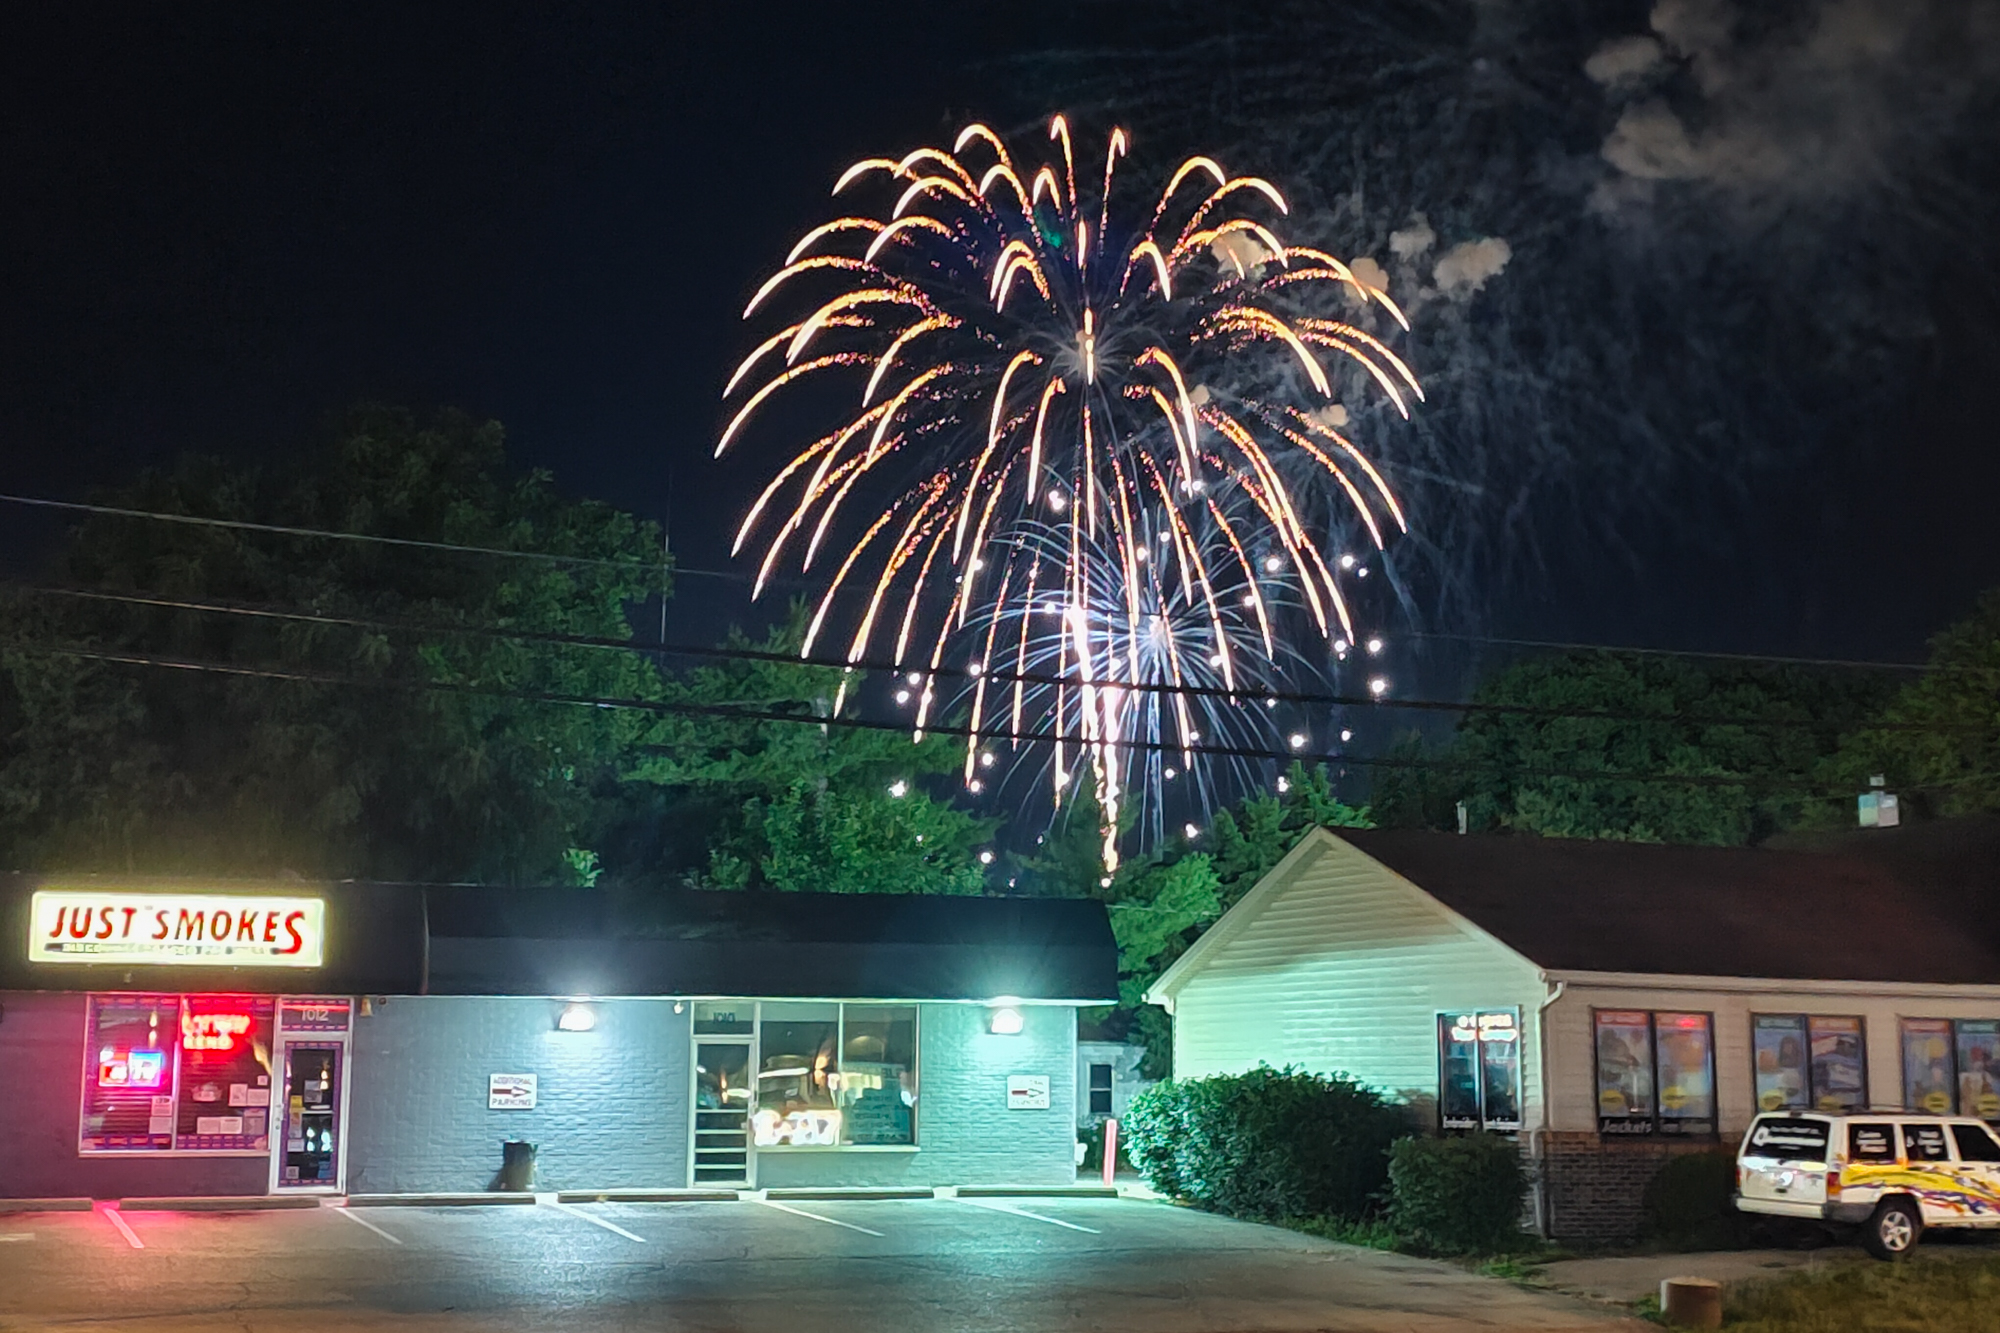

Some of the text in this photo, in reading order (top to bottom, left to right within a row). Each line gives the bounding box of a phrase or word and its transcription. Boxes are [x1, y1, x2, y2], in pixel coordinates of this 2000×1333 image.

[49, 906, 304, 954] JUST SMOKES
[301, 1009, 329, 1022] 1012
